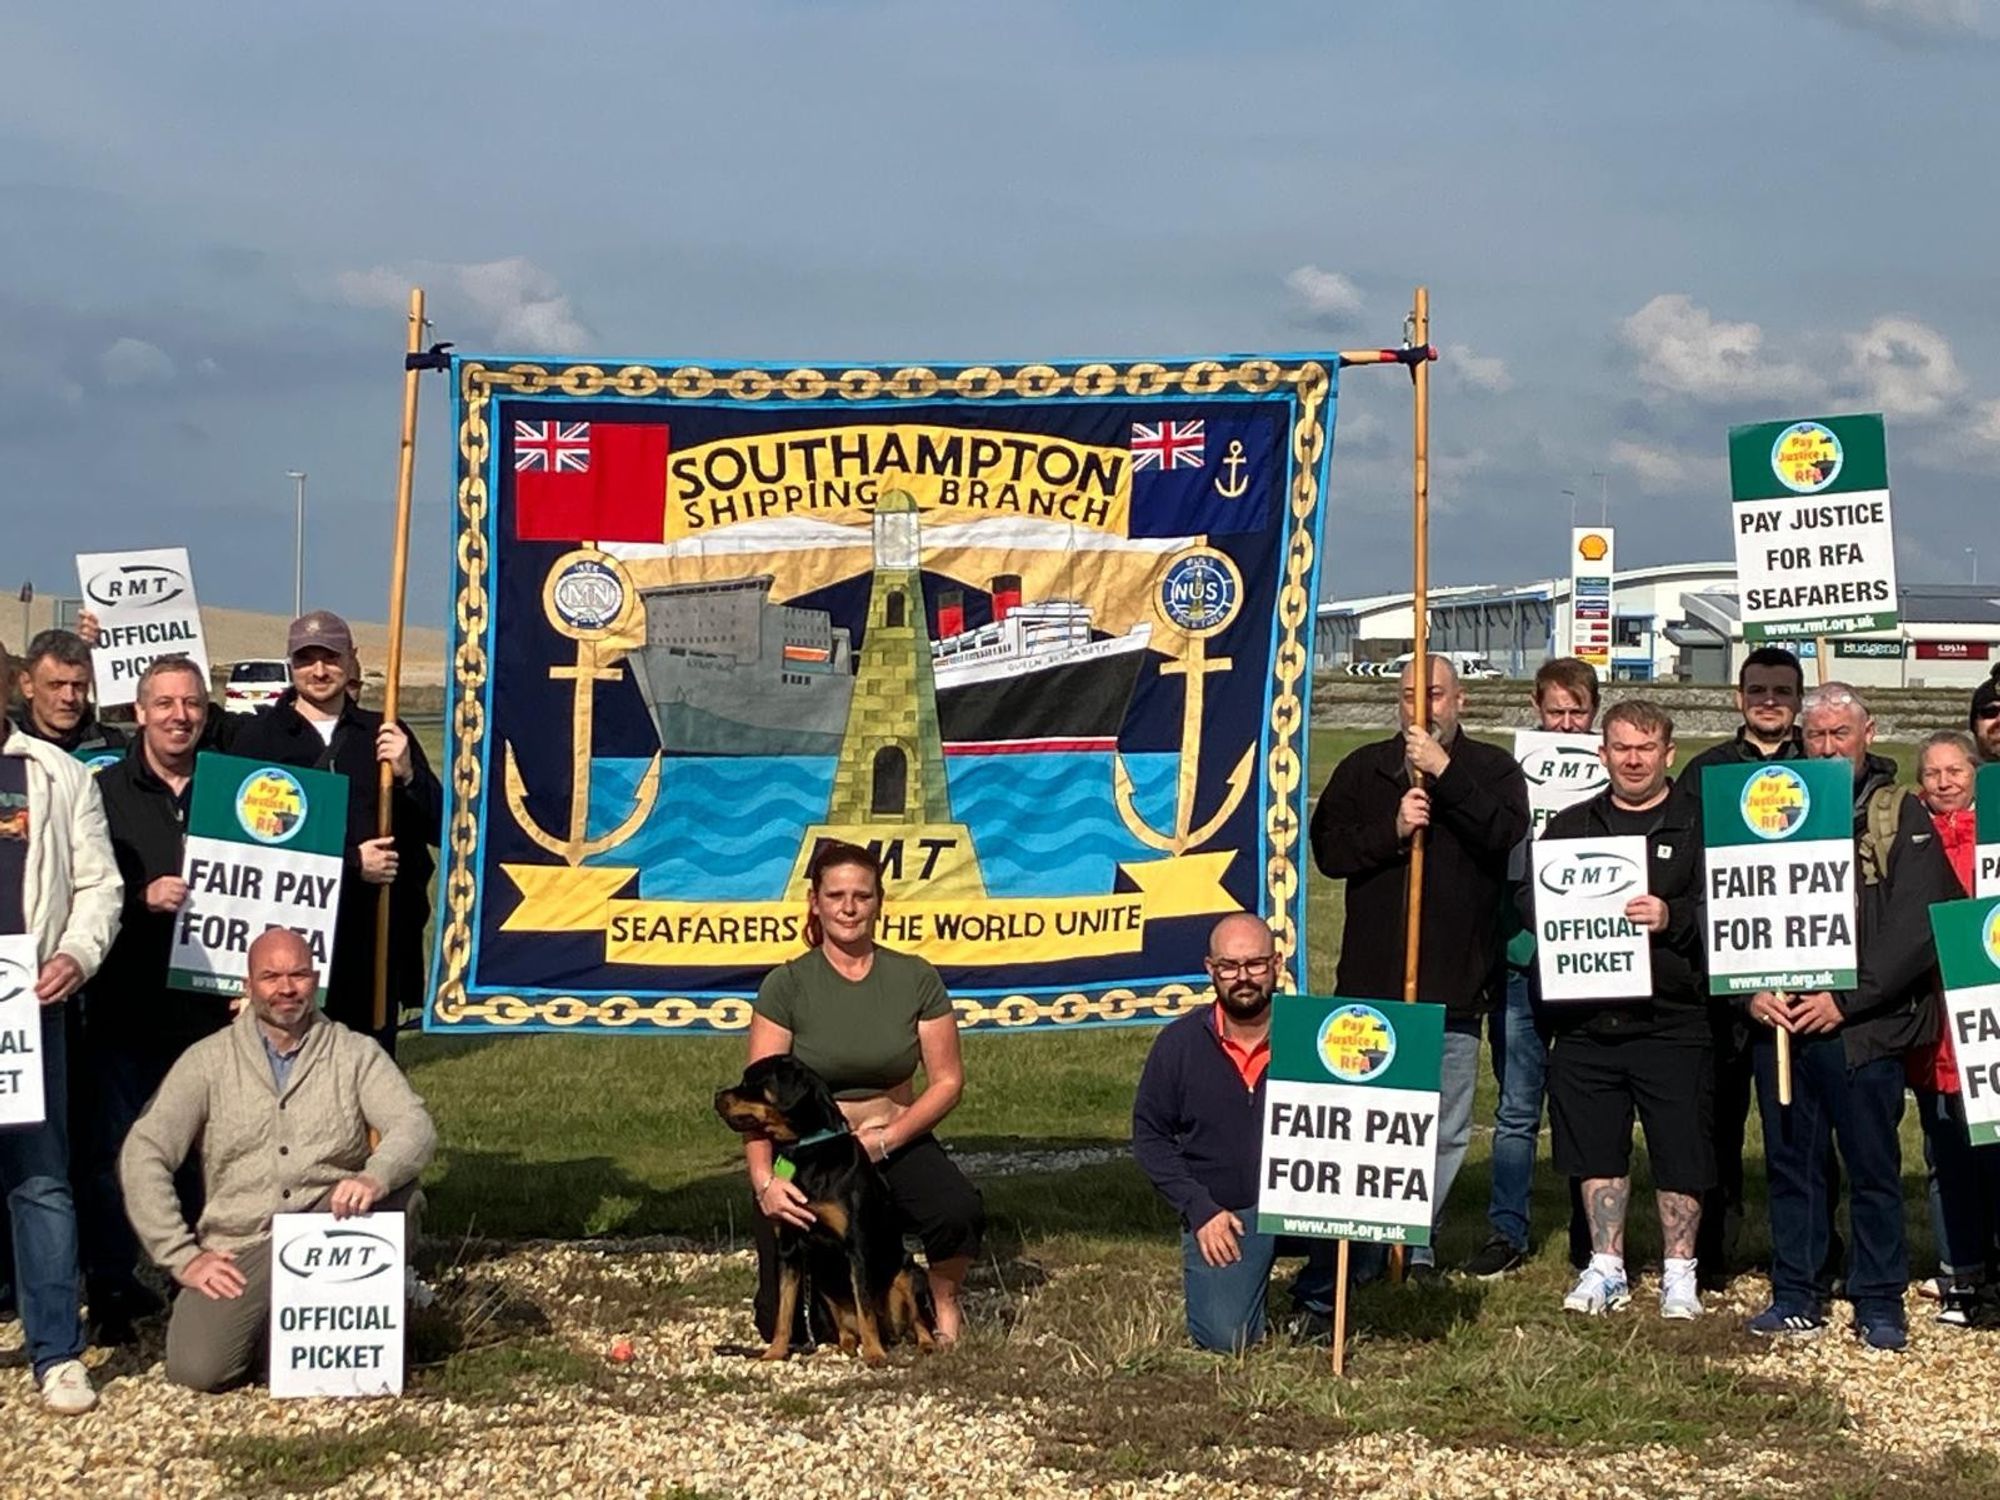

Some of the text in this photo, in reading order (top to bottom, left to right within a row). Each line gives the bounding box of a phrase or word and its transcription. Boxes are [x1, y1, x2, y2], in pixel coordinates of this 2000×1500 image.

[672, 432, 1123, 500] SOUTHAMPTON
[684, 479, 1110, 528] SHIPPING BRANCH
[1740, 502, 1884, 534] PAY JUSTICE
[1766, 543, 1864, 571] FOR RFA
[109, 577, 168, 597] RMT
[1175, 582, 1218, 600] NUS
[1747, 580, 1888, 611] SEAFARERS
[98, 620, 197, 649] OFFICIAL
[1763, 615, 1875, 635] www.rmt.org.uk
[1539, 761, 1599, 779] RMT
[188, 858, 336, 909] FAIR PAY
[1561, 866, 1622, 885] RMT
[1711, 861, 1850, 899] FAIR PAY
[180, 912, 250, 953] FOR
[611, 915, 799, 944] SEAFARERS
[934, 912, 1045, 941] WORLD
[1055, 905, 1141, 936] UNITE
[1543, 916, 1642, 942] OFFICIAL
[1713, 913, 1852, 952] FOR RFA
[1556, 951, 1634, 974] PICKET
[1729, 972, 1834, 990] www.rmt.org.uk
[1325, 1033, 1370, 1046] Justice
[1342, 1019, 1365, 1035] Pay
[1270, 1102, 1434, 1146] FAIR PAY
[1268, 1157, 1429, 1202] FOR RFA
[1284, 1218, 1405, 1240] www.rmt.org.uk
[304, 1247, 376, 1267] RMT
[279, 1306, 397, 1331] OFFICIAL
[291, 1345, 384, 1369] PICKET
